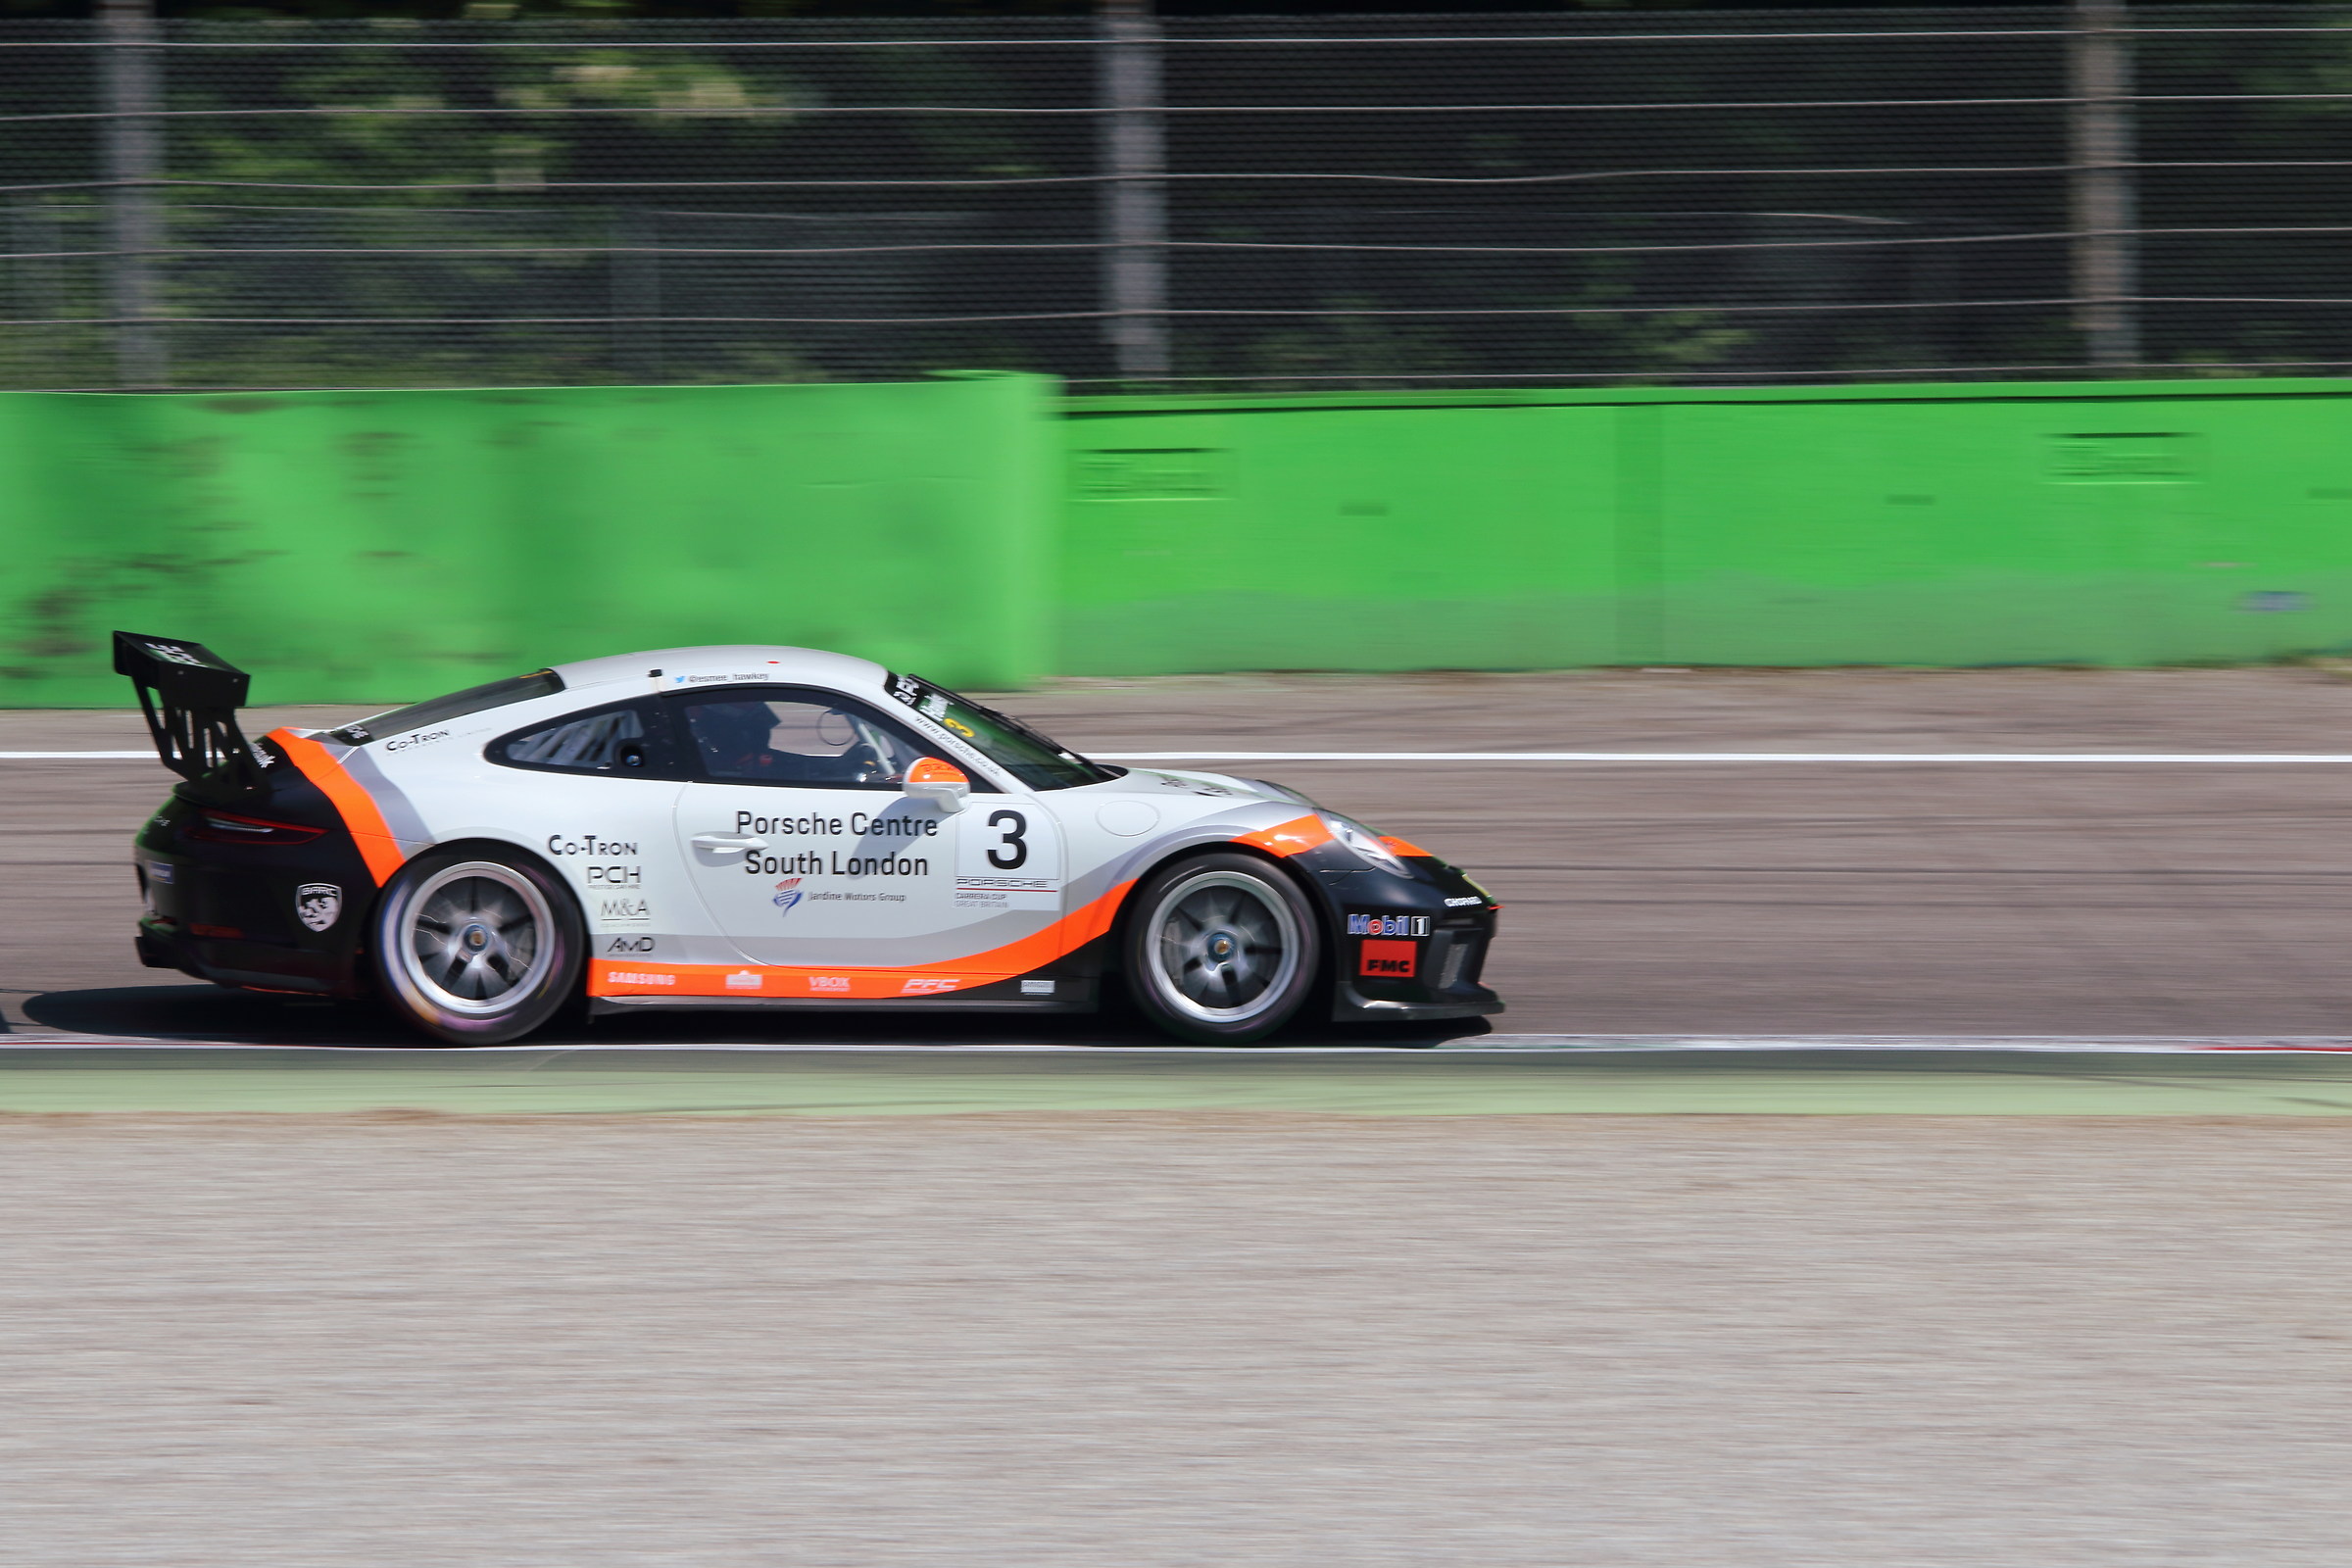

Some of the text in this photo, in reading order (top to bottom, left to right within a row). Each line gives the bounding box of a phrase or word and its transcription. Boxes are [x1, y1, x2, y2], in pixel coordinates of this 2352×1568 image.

[944, 717, 975, 738] 3
[916, 714, 1001, 777] www.porsche.co.uk
[737, 810, 938, 837] Porsche Centre
[987, 809, 1027, 870] 3
[745, 850, 928, 876] South London
[588, 866, 641, 883] PCH
[956, 878, 1049, 888] PORSCHE
[302, 886, 338, 897] BARC
[808, 891, 906, 903] Jardine Motors Group
[601, 899, 651, 916] M&A
[1348, 914, 1409, 935] Mobil
[1367, 959, 1410, 972] FMC
[608, 972, 675, 985] SAMSUNG
[808, 976, 851, 987] VBOX
[904, 978, 960, 989] PFC
